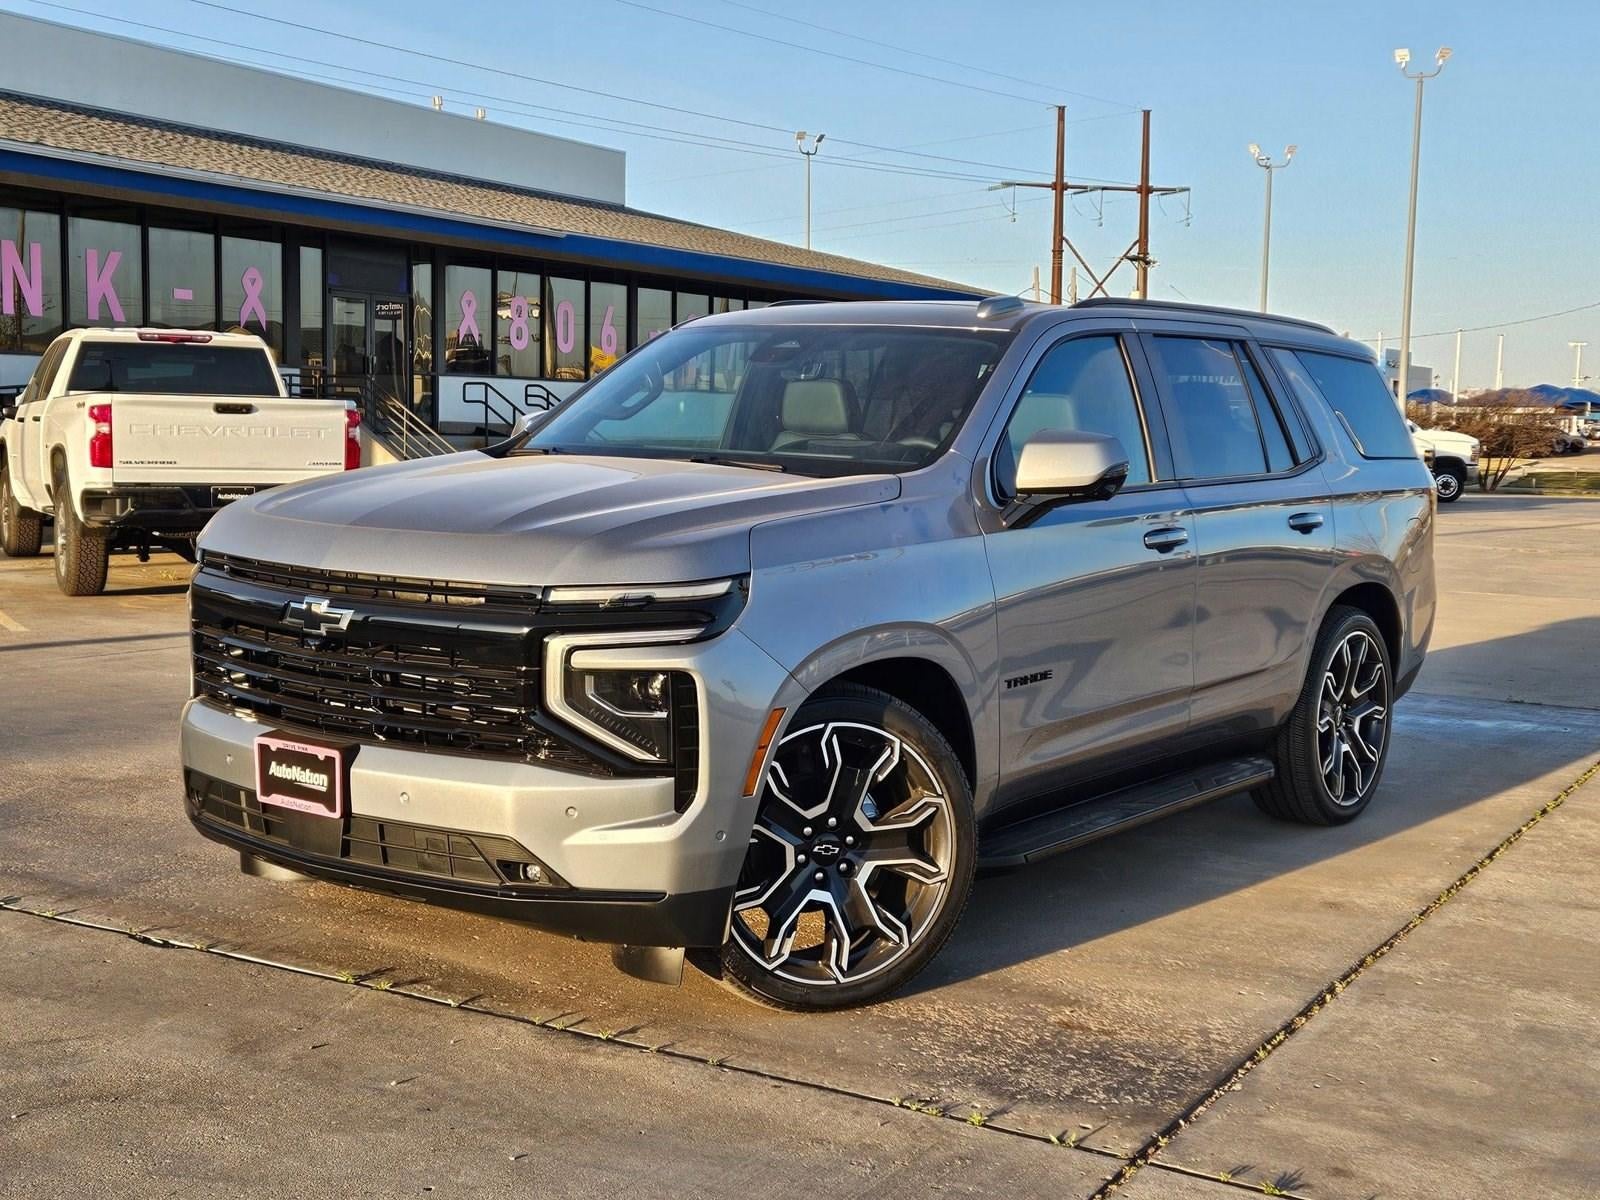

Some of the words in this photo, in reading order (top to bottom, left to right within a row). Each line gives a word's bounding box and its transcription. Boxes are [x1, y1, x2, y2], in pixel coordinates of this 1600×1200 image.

[129, 423, 332, 440] CHEVROLET
[1004, 669, 1053, 689] TAHOE
[268, 761, 328, 788] AutoNation
